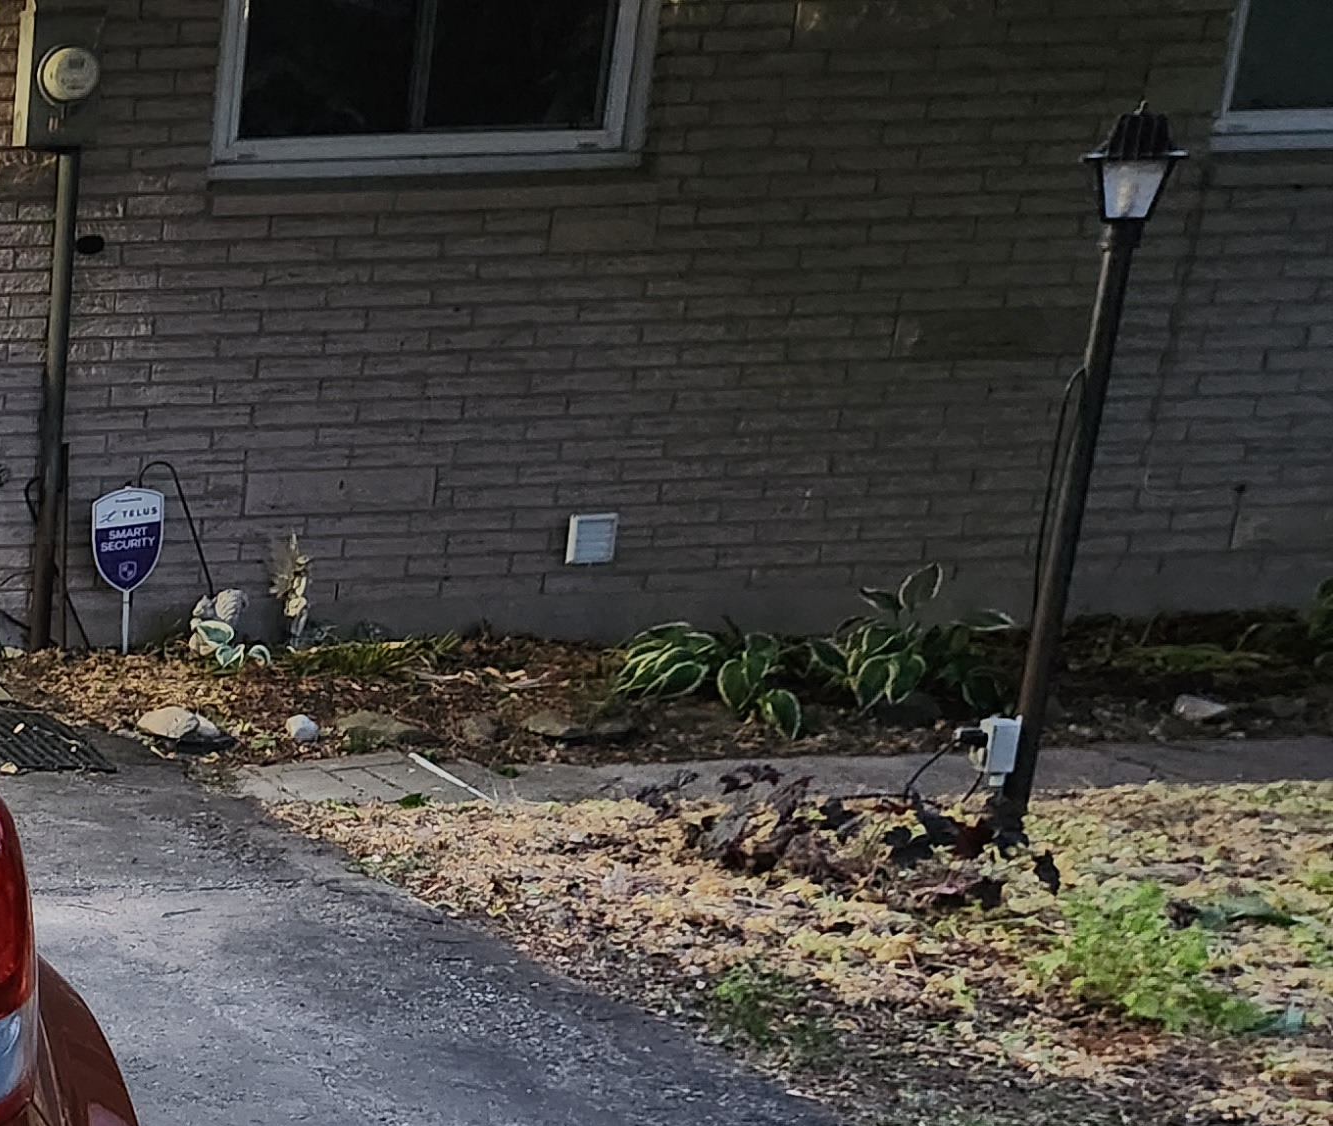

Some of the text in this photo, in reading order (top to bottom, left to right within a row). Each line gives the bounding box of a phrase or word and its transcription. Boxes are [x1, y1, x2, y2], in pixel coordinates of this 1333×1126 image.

[121, 506, 158, 519] TELUS
[108, 526, 148, 540] SMART
[100, 537, 155, 552] SECURITY
